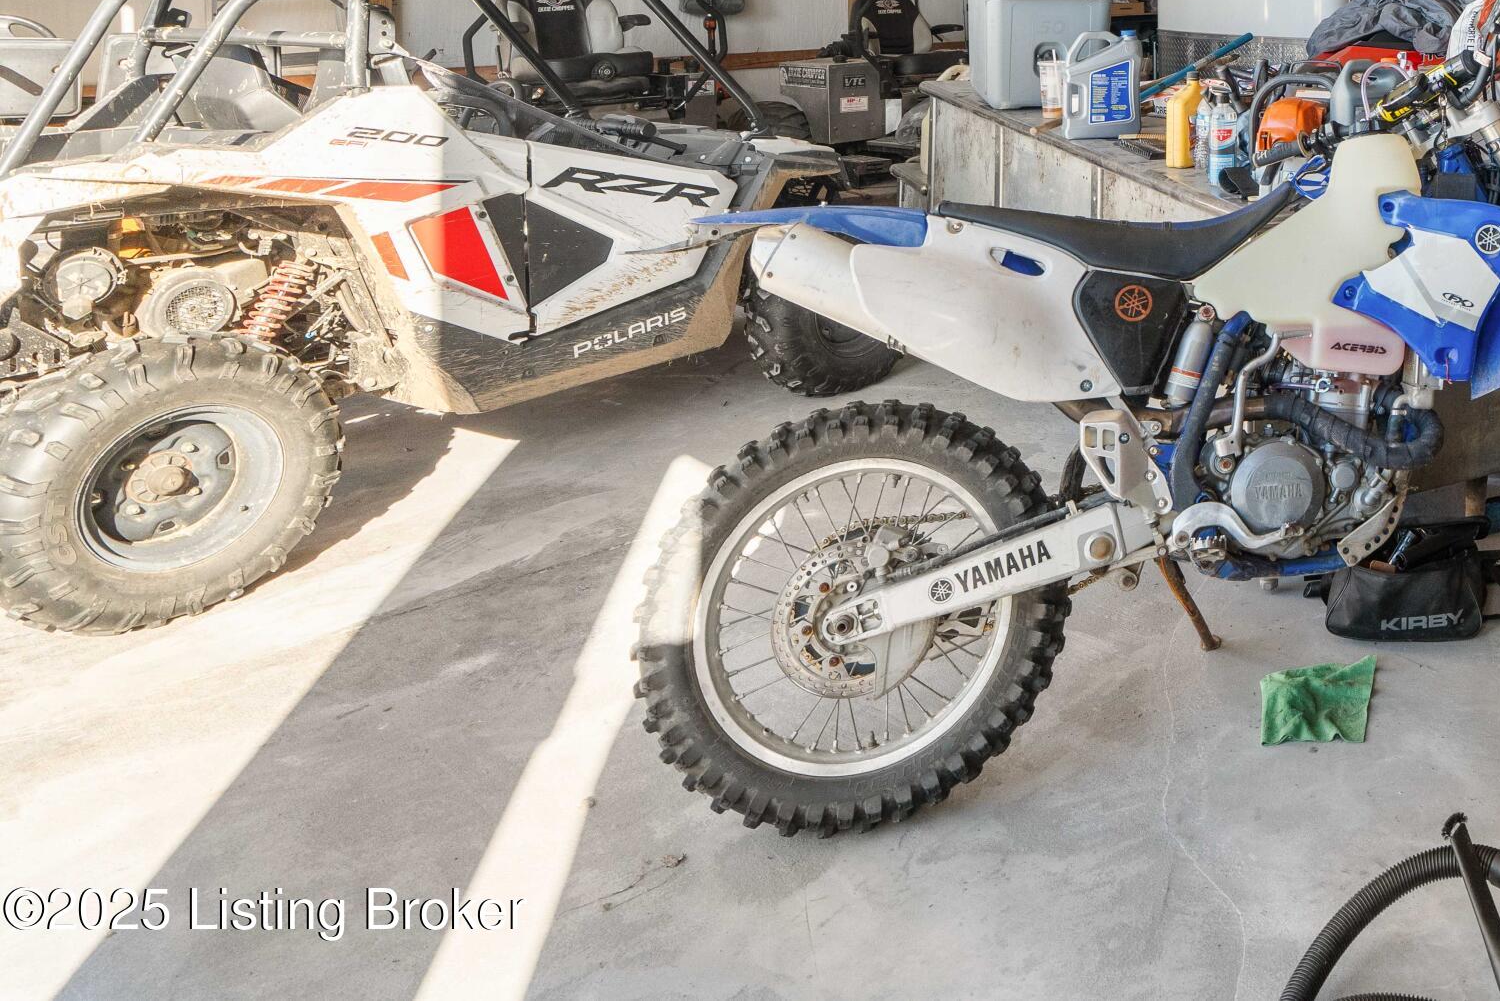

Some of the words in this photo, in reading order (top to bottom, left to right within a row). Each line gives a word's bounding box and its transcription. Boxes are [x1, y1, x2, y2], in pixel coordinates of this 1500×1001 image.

[328, 138, 369, 149] EFI
[346, 126, 449, 148] 200
[543, 166, 721, 207] RZR
[572, 306, 687, 359] POLARIS
[1331, 342, 1387, 355] ACERBIS
[1253, 483, 1303, 501] YAMAHA
[954, 540, 1053, 593] YAMAHA
[1381, 609, 1464, 631] KIRBY
